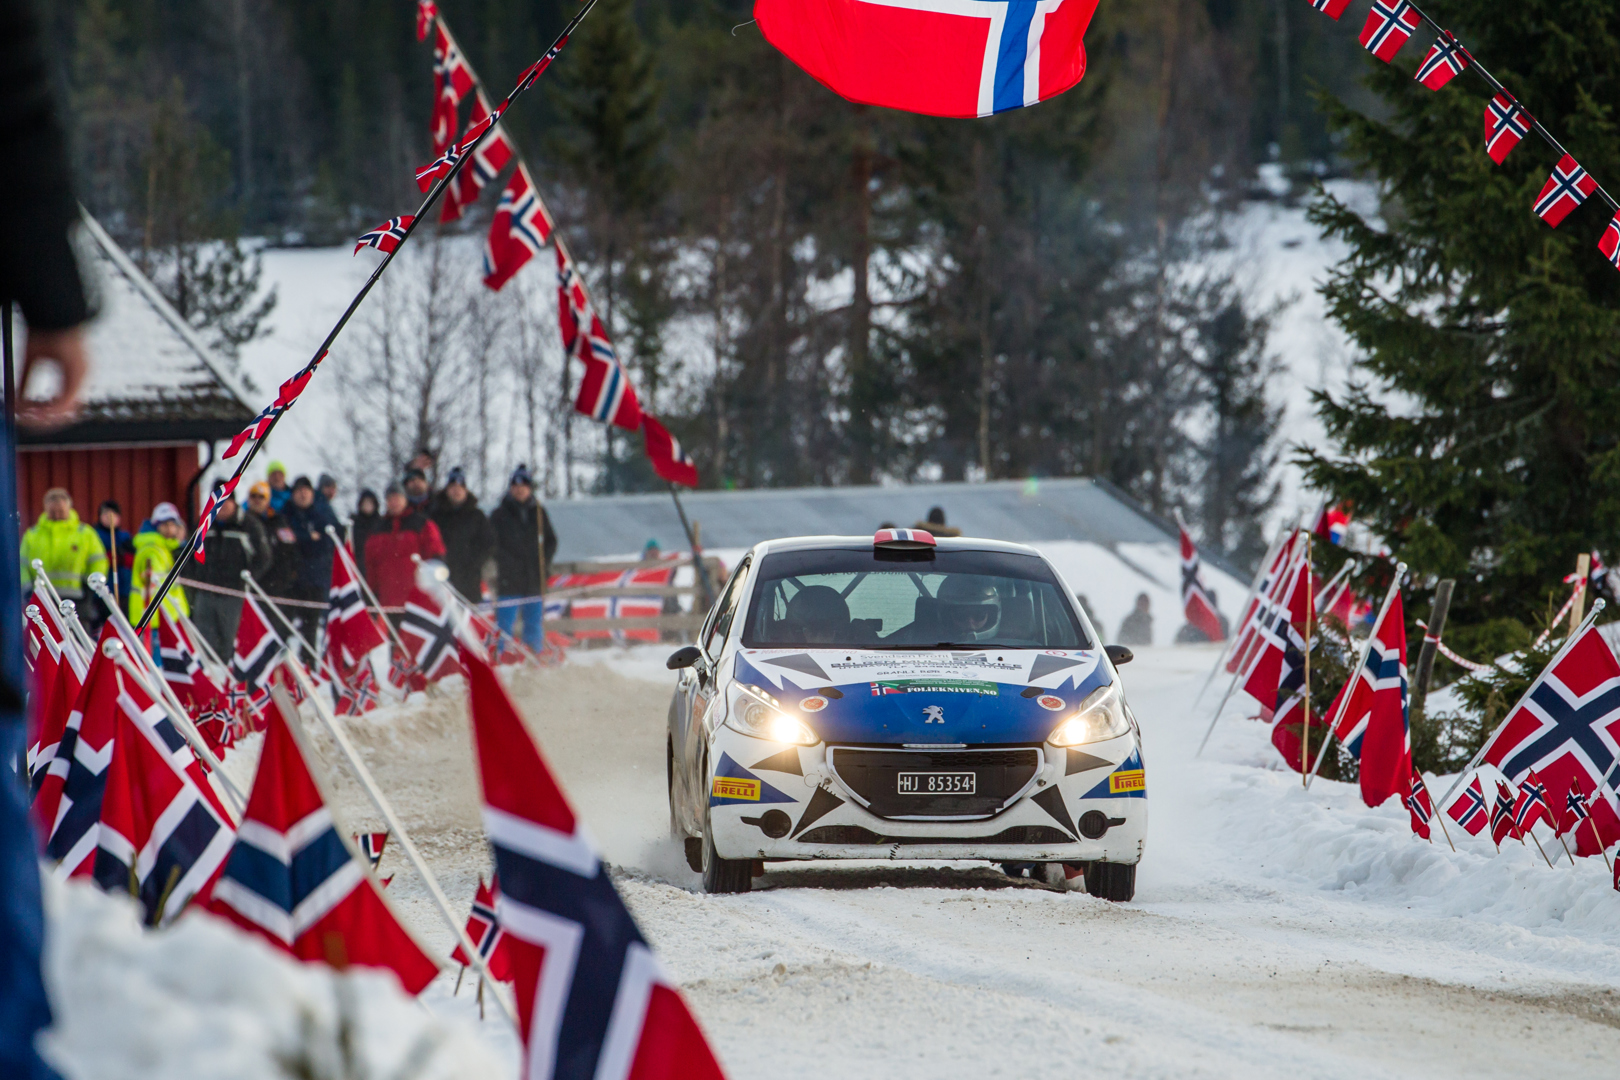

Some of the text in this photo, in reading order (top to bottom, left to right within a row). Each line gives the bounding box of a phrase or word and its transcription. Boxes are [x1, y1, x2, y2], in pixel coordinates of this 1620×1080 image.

[714, 780, 756, 797] PIRELLI
[903, 776, 970, 791] HJ 85354
[1114, 773, 1145, 790] PIRELL
